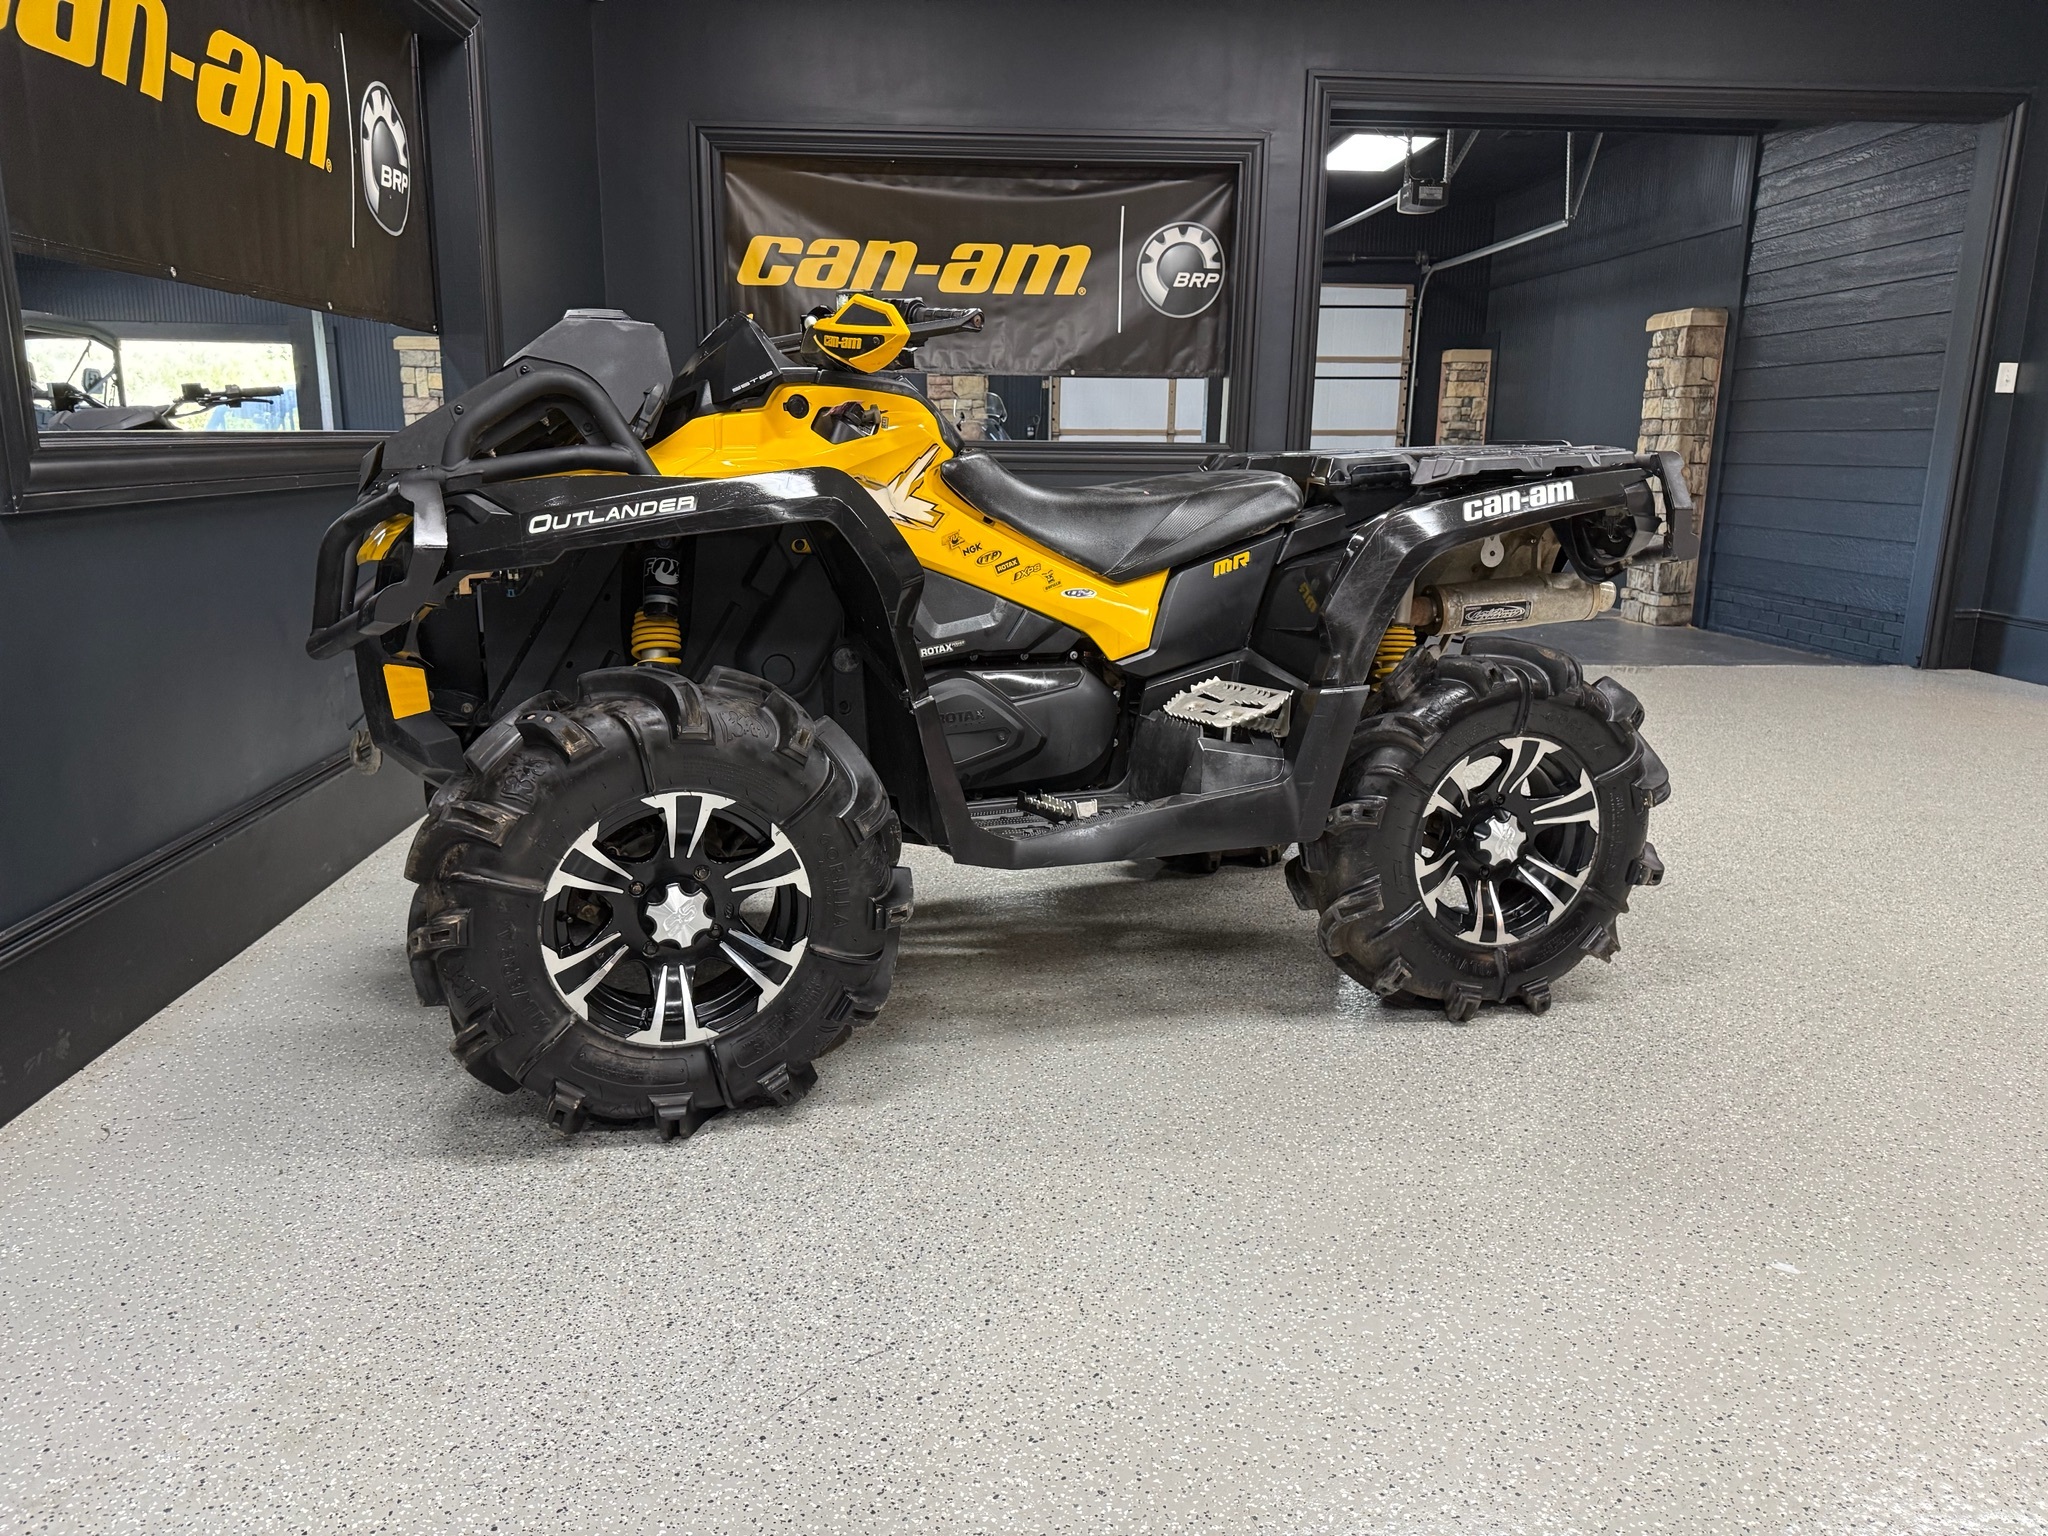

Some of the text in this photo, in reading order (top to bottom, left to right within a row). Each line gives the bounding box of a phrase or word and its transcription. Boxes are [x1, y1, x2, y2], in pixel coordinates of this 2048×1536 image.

[0, 0, 330, 170] an-am
[381, 164, 408, 194] BRP
[1172, 271, 1220, 288] BRP
[823, 334, 862, 350] can-am
[1463, 480, 1575, 522] can-am
[528, 495, 698, 534] OUTLANDER
[962, 542, 983, 557] NGK
[977, 550, 1001, 565] ITP
[644, 557, 680, 577] FOX
[996, 559, 1019, 573] ROTAX
[920, 642, 954, 658] ROTAX
